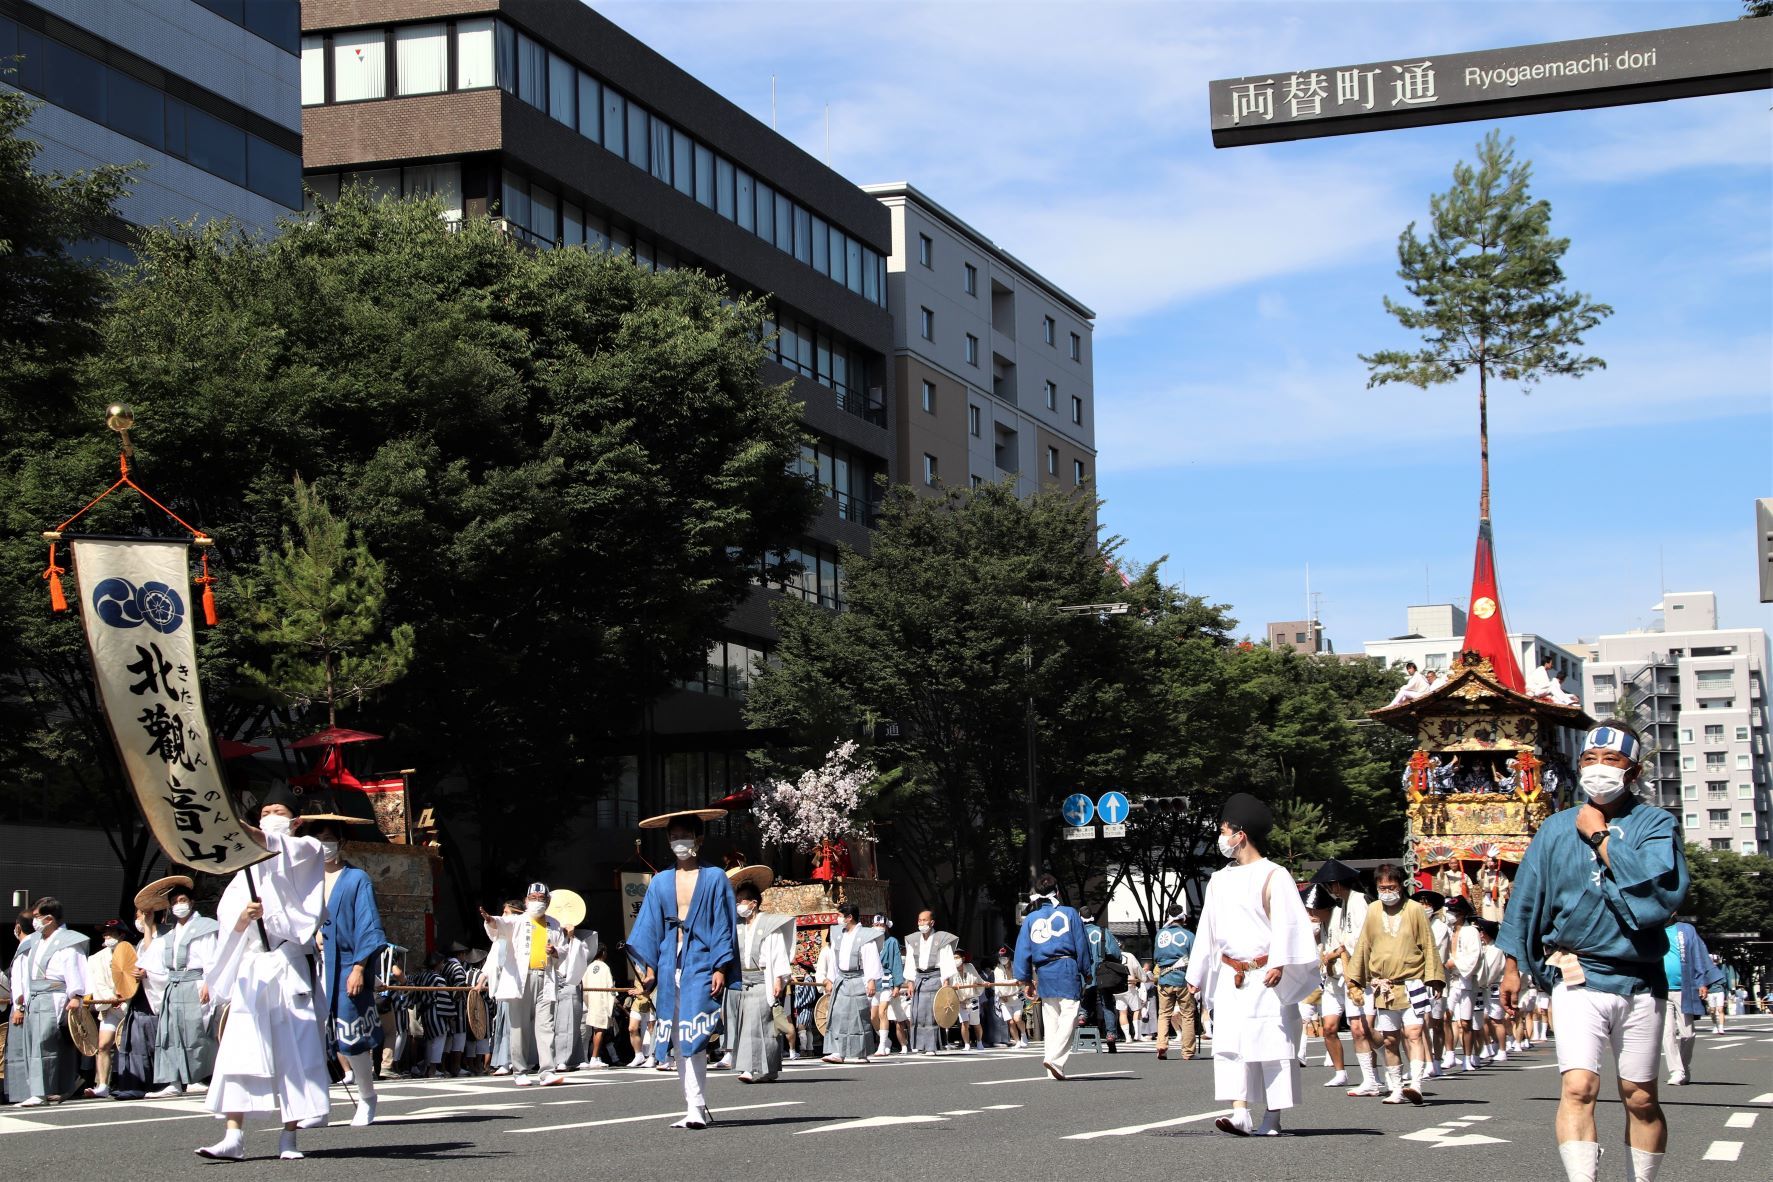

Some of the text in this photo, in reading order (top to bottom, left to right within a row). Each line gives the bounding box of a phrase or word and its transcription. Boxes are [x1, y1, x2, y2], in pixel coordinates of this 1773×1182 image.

[1230, 61, 1439, 125] 両替町通
[1465, 48, 1657, 89] Ryogaemachi dori
